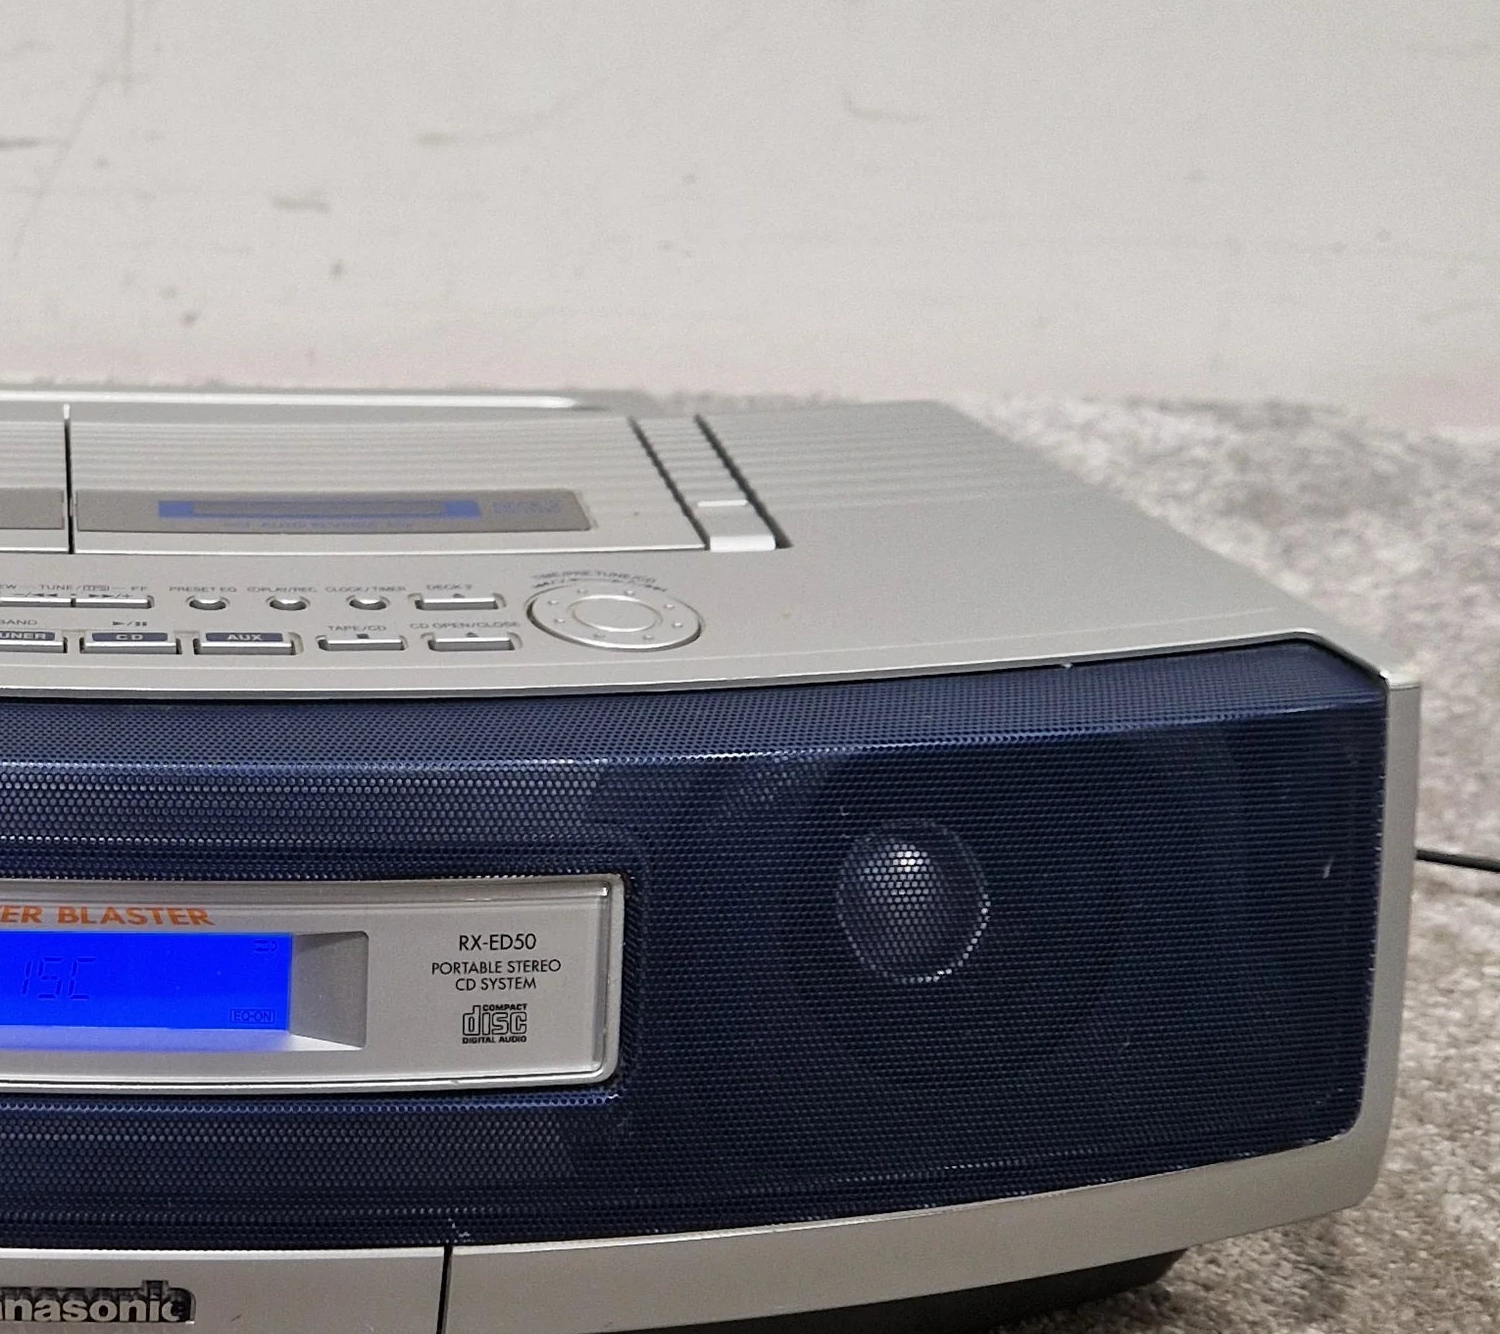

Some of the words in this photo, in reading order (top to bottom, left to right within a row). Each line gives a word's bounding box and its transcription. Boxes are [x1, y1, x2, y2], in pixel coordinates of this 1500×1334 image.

[426, 583, 460, 591] DECK
[432, 621, 523, 629] OPEN/CLOSE
[115, 633, 143, 641] CD
[226, 633, 263, 641] AUX
[56, 906, 216, 926] BLASTER
[459, 933, 537, 951] RX-ED50
[431, 960, 503, 975] PORTABLE
[506, 958, 562, 974] STEREO
[455, 978, 477, 991] CD
[480, 976, 537, 991] SYSTEM
[482, 1003, 528, 1012] COMPACT
[462, 1035, 497, 1045] DIGITAL
[498, 1035, 528, 1044] AUDIO
